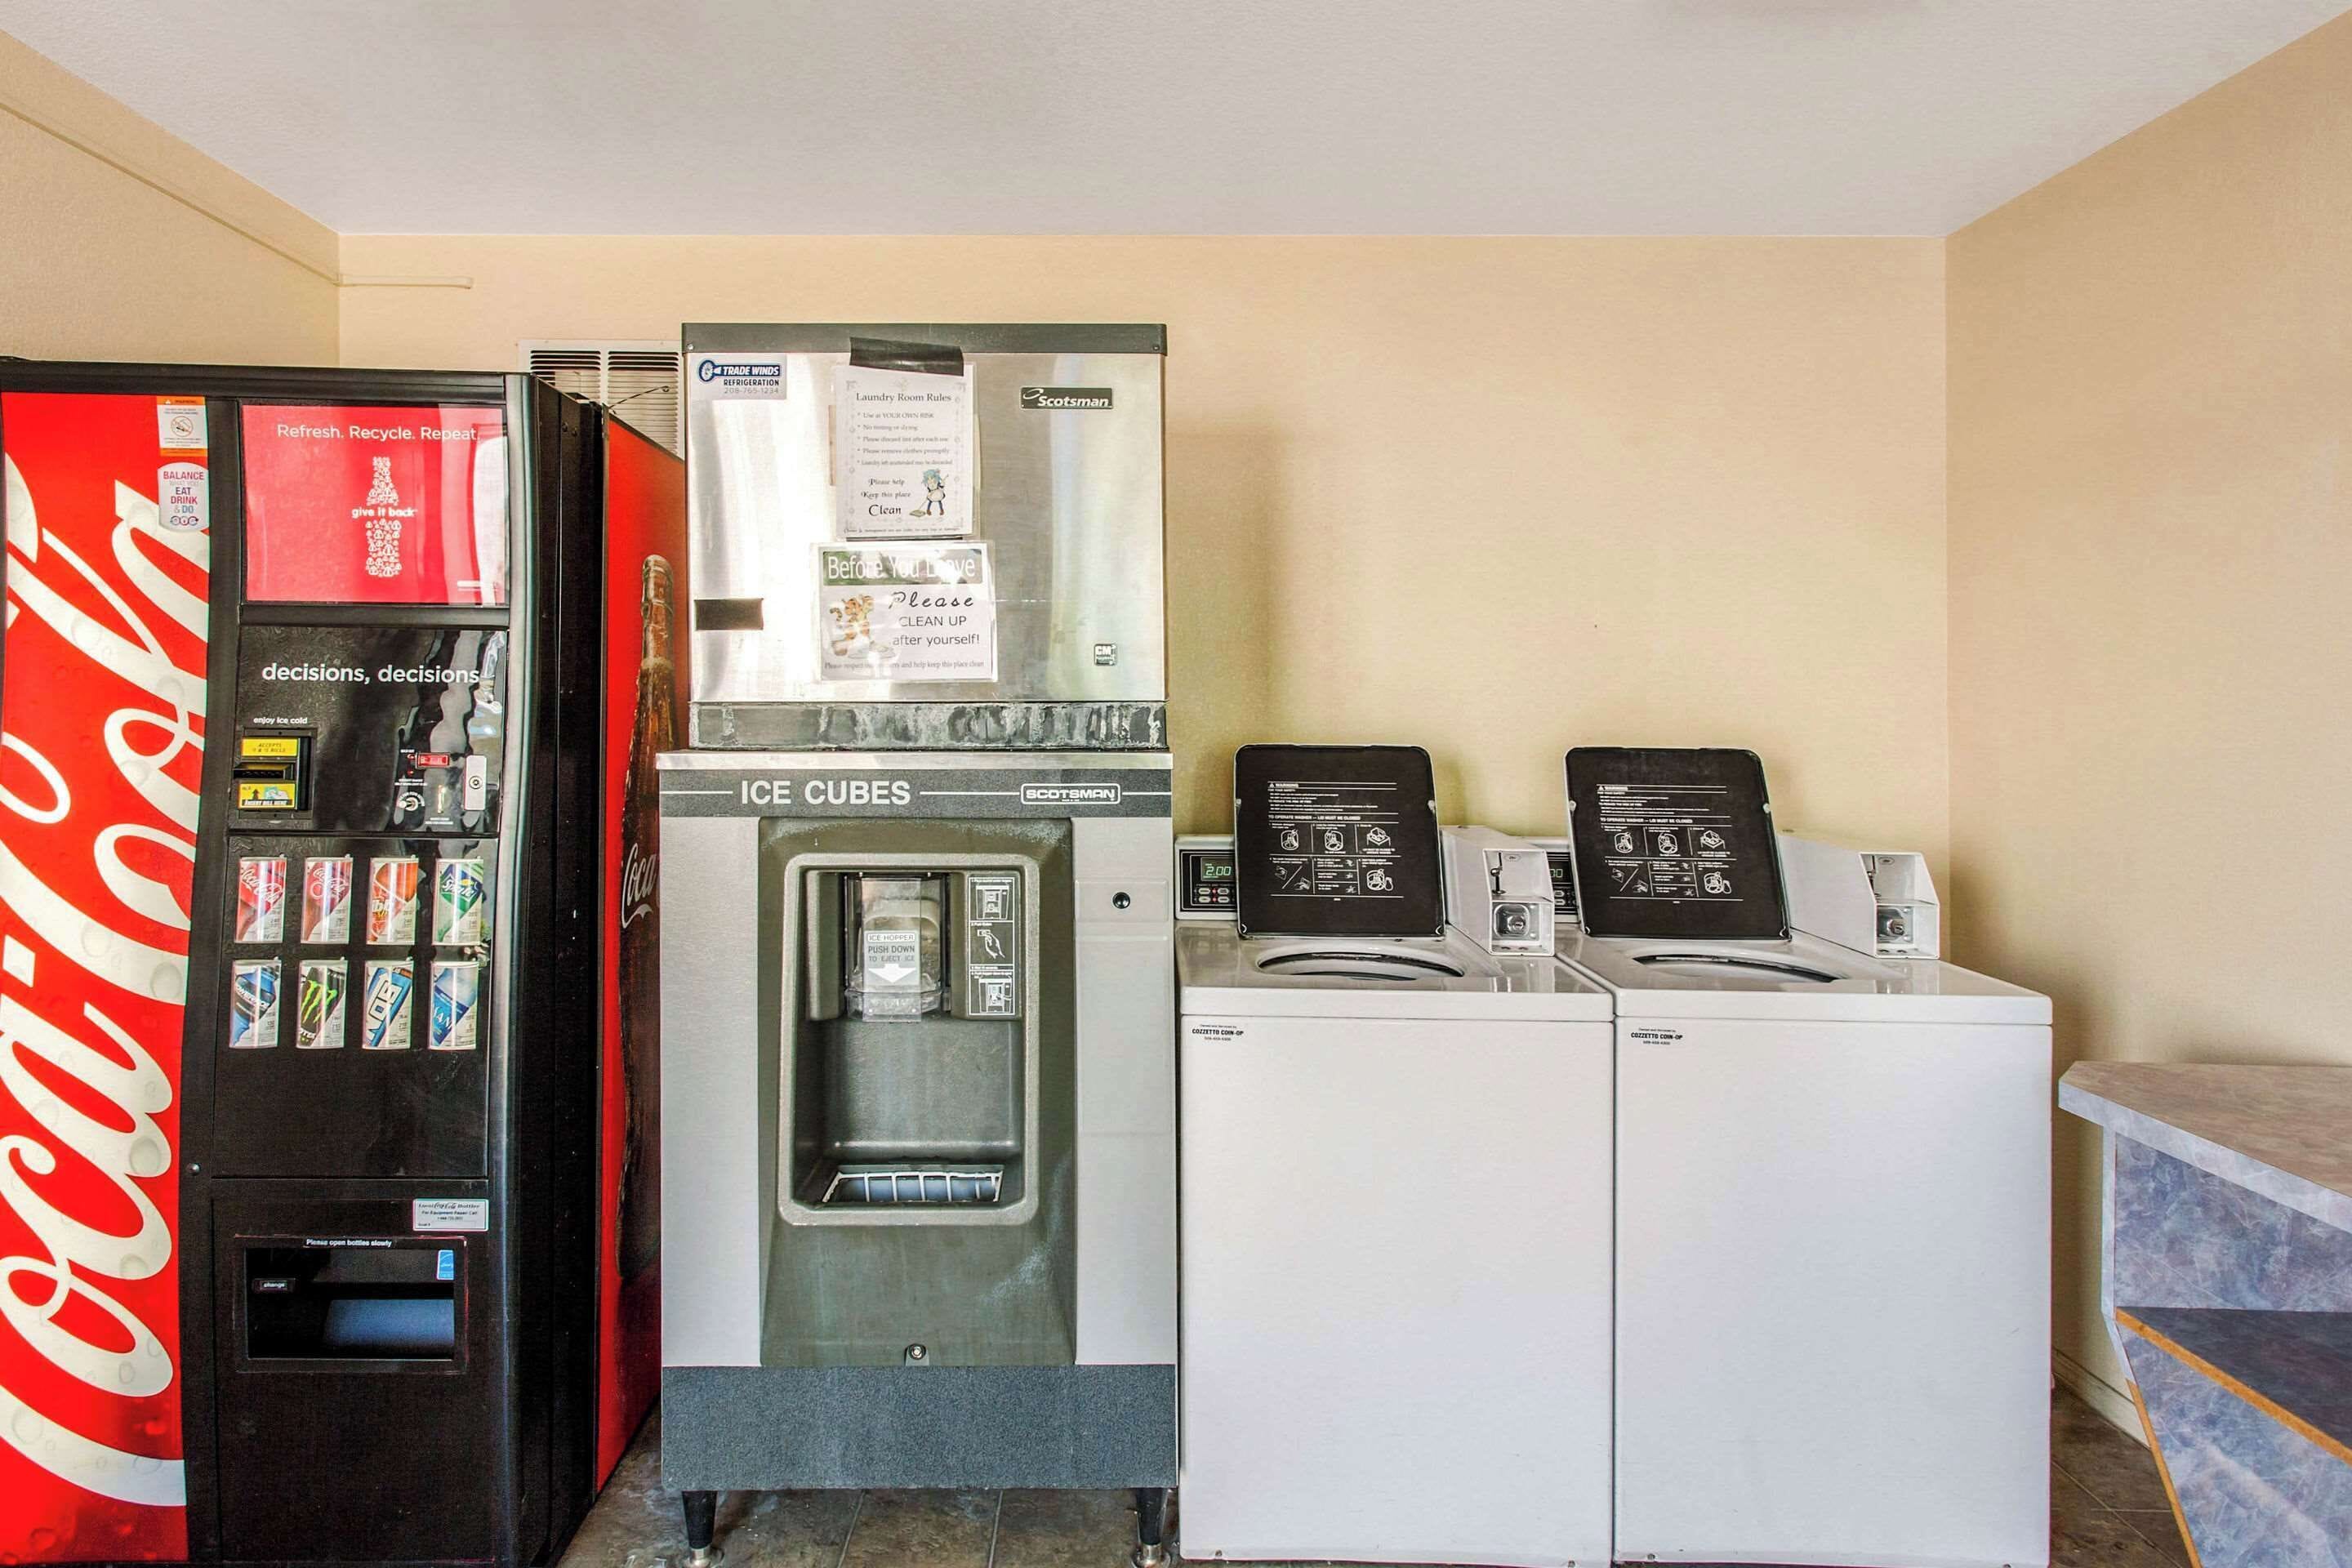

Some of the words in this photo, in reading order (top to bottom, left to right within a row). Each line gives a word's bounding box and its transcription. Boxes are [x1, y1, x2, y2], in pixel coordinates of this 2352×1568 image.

[723, 366, 751, 376] TRADE
[751, 366, 779, 376] WINDS
[856, 393, 895, 404] Laundry
[898, 393, 924, 402] Room
[927, 393, 952, 402] Rules
[1037, 396, 1109, 407] Scotsman
[277, 425, 344, 439] Refresh.
[350, 425, 415, 442] Recycle.
[421, 426, 480, 441] Repeat.
[163, 471, 204, 480] BALANCE
[868, 479, 890, 487] Please
[171, 496, 198, 505] DRINK
[861, 492, 880, 500] Keep
[181, 506, 194, 514] DO
[352, 508, 375, 519] give
[378, 507, 385, 517] it
[389, 507, 415, 517] back
[868, 504, 902, 517] Clean
[828, 555, 883, 579] Before
[889, 555, 919, 578] You
[927, 558, 975, 577] Lve
[889, 591, 973, 609] Please
[898, 616, 943, 627] CLEAN
[949, 616, 967, 626] UP
[893, 635, 922, 645] after
[926, 634, 980, 647] yourself!
[913, 661, 925, 669] help
[927, 661, 941, 669] keep
[954, 660, 969, 668] place
[262, 662, 371, 684] decisions,
[378, 664, 480, 683] decisions
[253, 717, 275, 725] enjoy
[742, 781, 791, 804] ICE
[804, 780, 911, 805] CUBES
[1026, 789, 1116, 800] SCOTSMAN
[1205, 866, 1232, 875] 2.00
[371, 1240, 392, 1248] slowly
